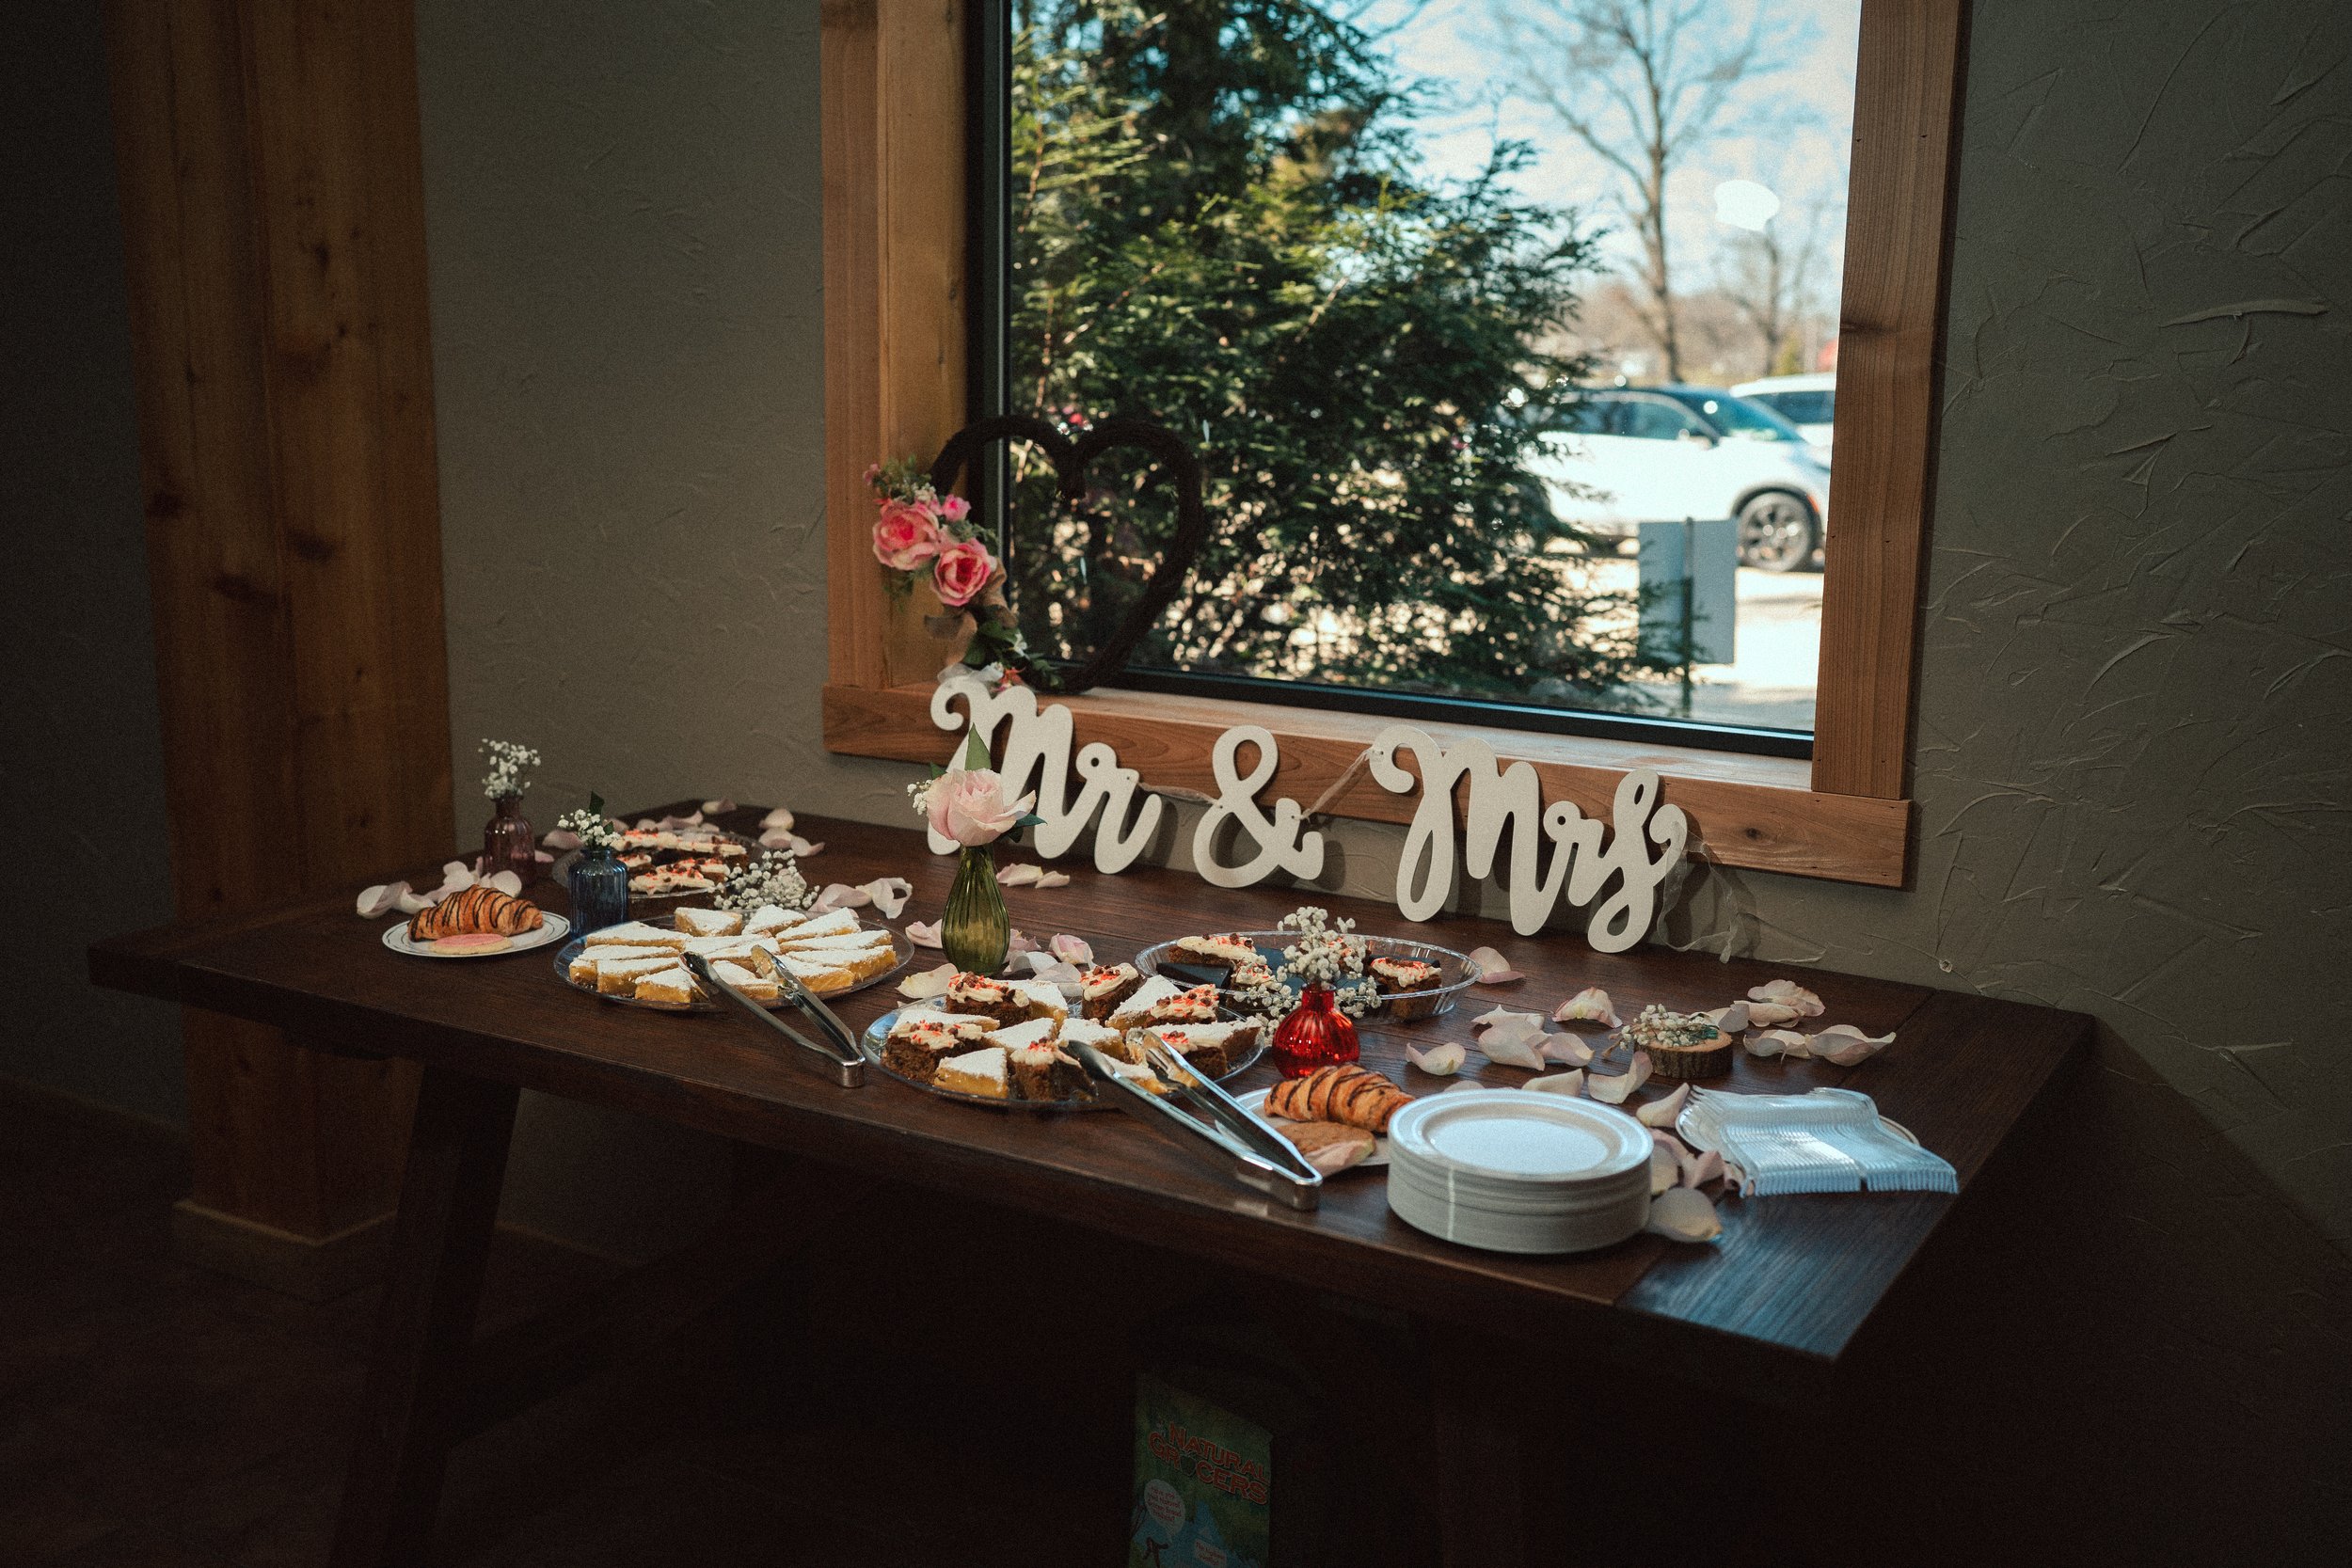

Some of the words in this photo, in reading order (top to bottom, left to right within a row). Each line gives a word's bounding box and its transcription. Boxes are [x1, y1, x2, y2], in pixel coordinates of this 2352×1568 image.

[927, 675, 1163, 875] Mr
[1193, 725, 1324, 888] &
[1371, 724, 1687, 953] Mrs
[1148, 1432, 1268, 1505] GROCERS
[1168, 1422, 1270, 1486] NATURAL
